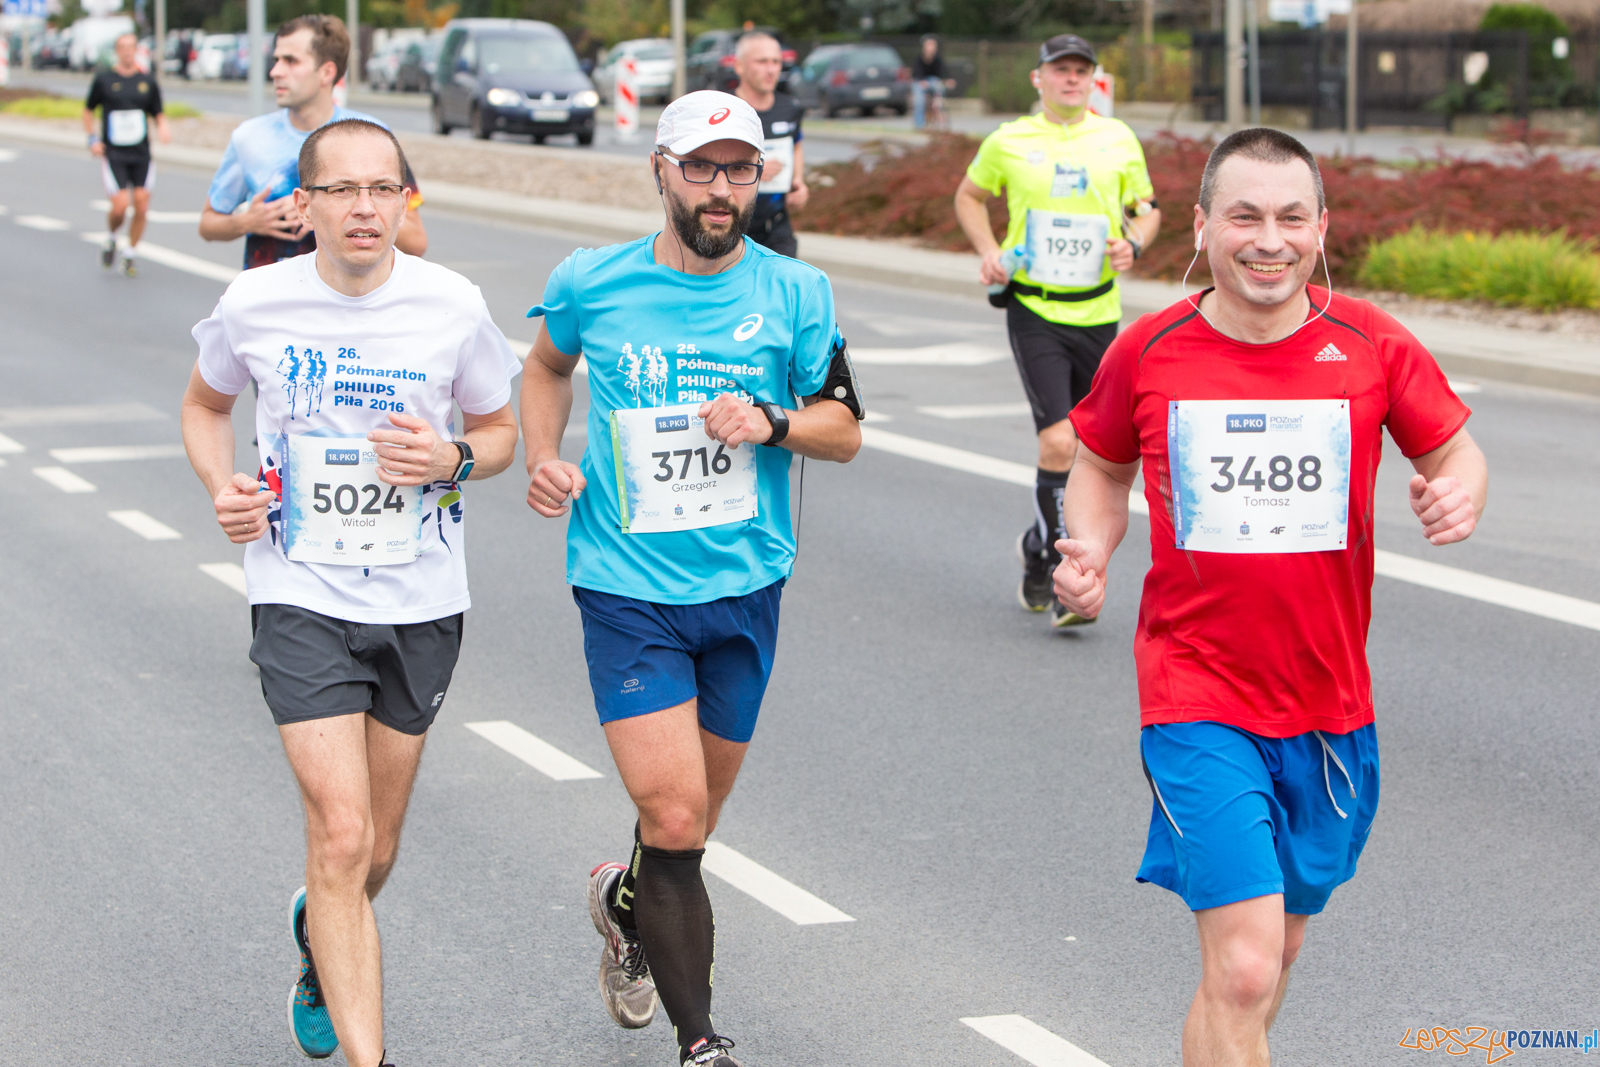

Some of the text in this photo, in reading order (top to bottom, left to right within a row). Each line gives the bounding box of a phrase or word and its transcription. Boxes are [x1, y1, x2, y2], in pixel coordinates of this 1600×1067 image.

[1046, 237, 1093, 256] 1939
[337, 347, 361, 359] 26.
[676, 343, 701, 354] 25.
[1314, 353, 1347, 362] adidas
[336, 364, 426, 382] Półmaraton
[676, 358, 764, 376] Półmaraton
[676, 375, 737, 389] PHILIPS
[334, 380, 396, 397] PHILIPS
[677, 390, 707, 402] Piła
[334, 395, 405, 413] Piła 2016
[669, 419, 686, 427] PKO
[1229, 419, 1263, 428] 18. PKO
[328, 453, 357, 461] 18. PKO
[651, 444, 732, 482] 3716
[1210, 455, 1322, 493] 3488
[672, 480, 717, 492] Grzegorz
[313, 482, 405, 515] 5024
[1243, 496, 1290, 507] Tomasz
[341, 518, 376, 527] Witold
[1270, 526, 1286, 535] 4F
